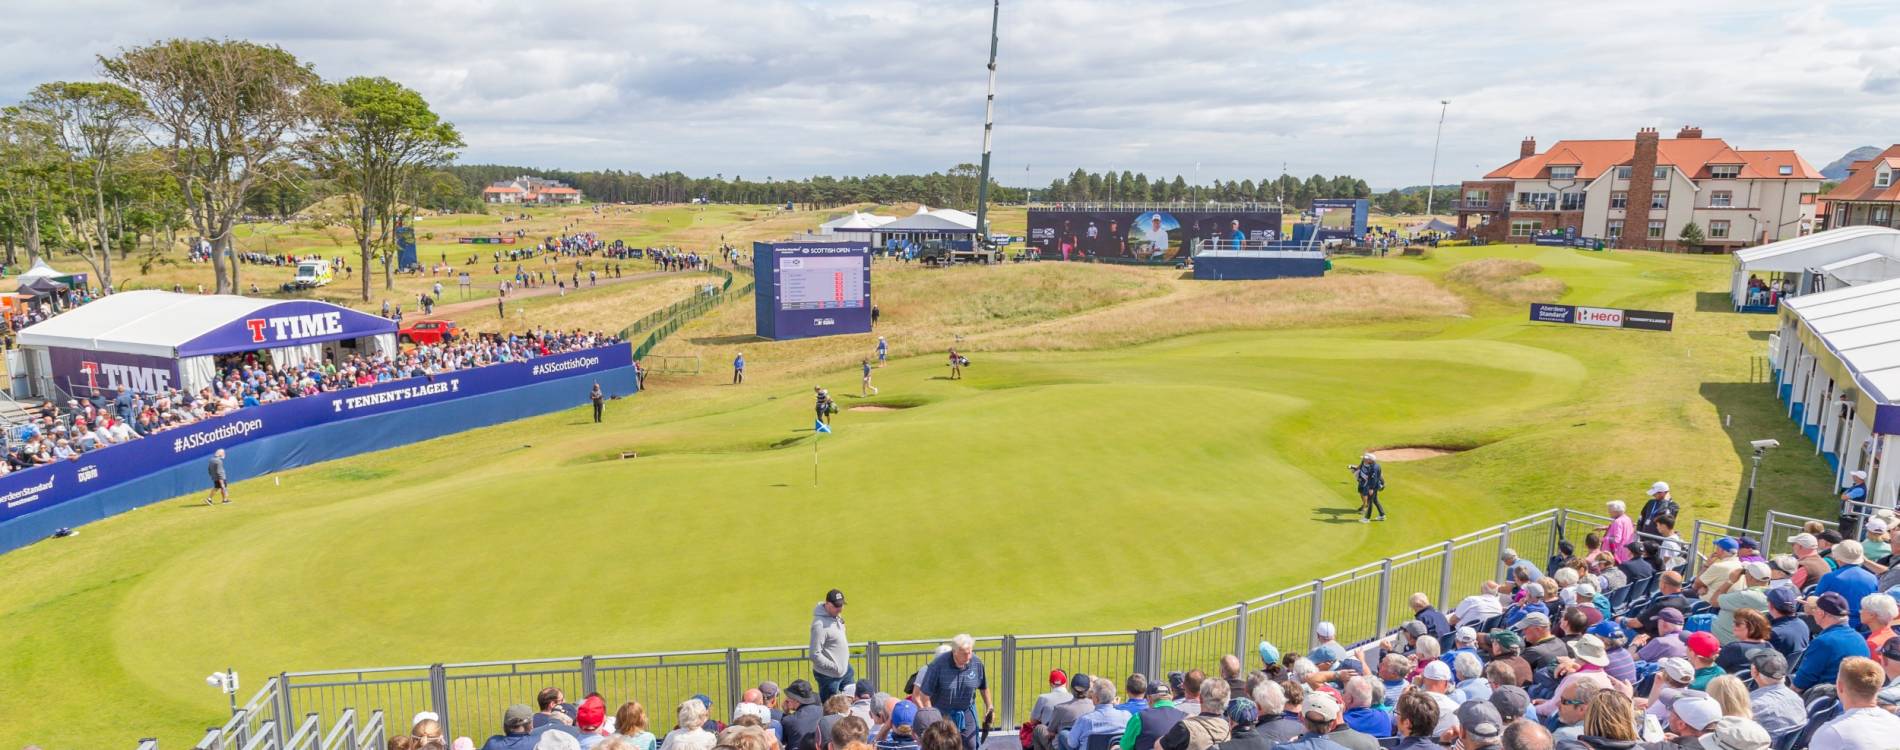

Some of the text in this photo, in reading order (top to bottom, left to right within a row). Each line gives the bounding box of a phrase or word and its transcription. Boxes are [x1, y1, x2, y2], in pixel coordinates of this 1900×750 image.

[247, 311, 343, 343] T TIME
[101, 363, 171, 394] TIME
[532, 356, 599, 376] #ASIScottishOpen
[346, 388, 411, 409] TENNENT'S
[412, 382, 449, 398] LAGER
[174, 419, 263, 453] #ASIScottishOpen
